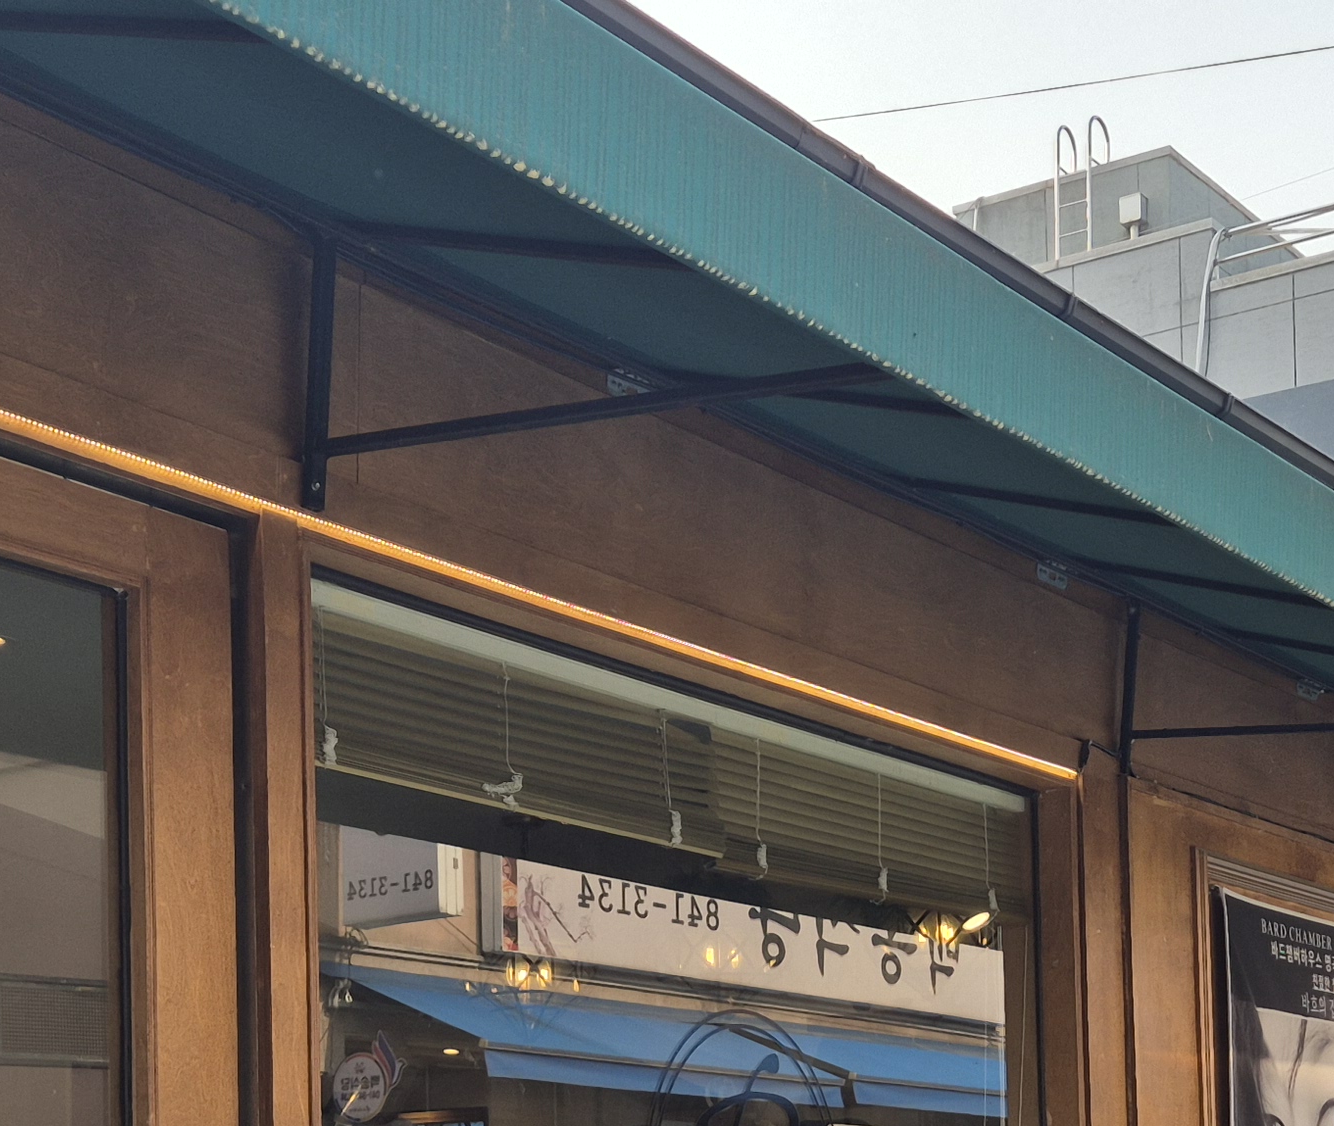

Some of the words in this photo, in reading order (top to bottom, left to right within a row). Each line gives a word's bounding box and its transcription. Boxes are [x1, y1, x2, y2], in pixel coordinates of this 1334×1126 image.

[1260, 917, 1287, 940] BARD
[1288, 926, 1333, 952] CHAMBER
[1301, 992, 1327, 1015] 바흐의
